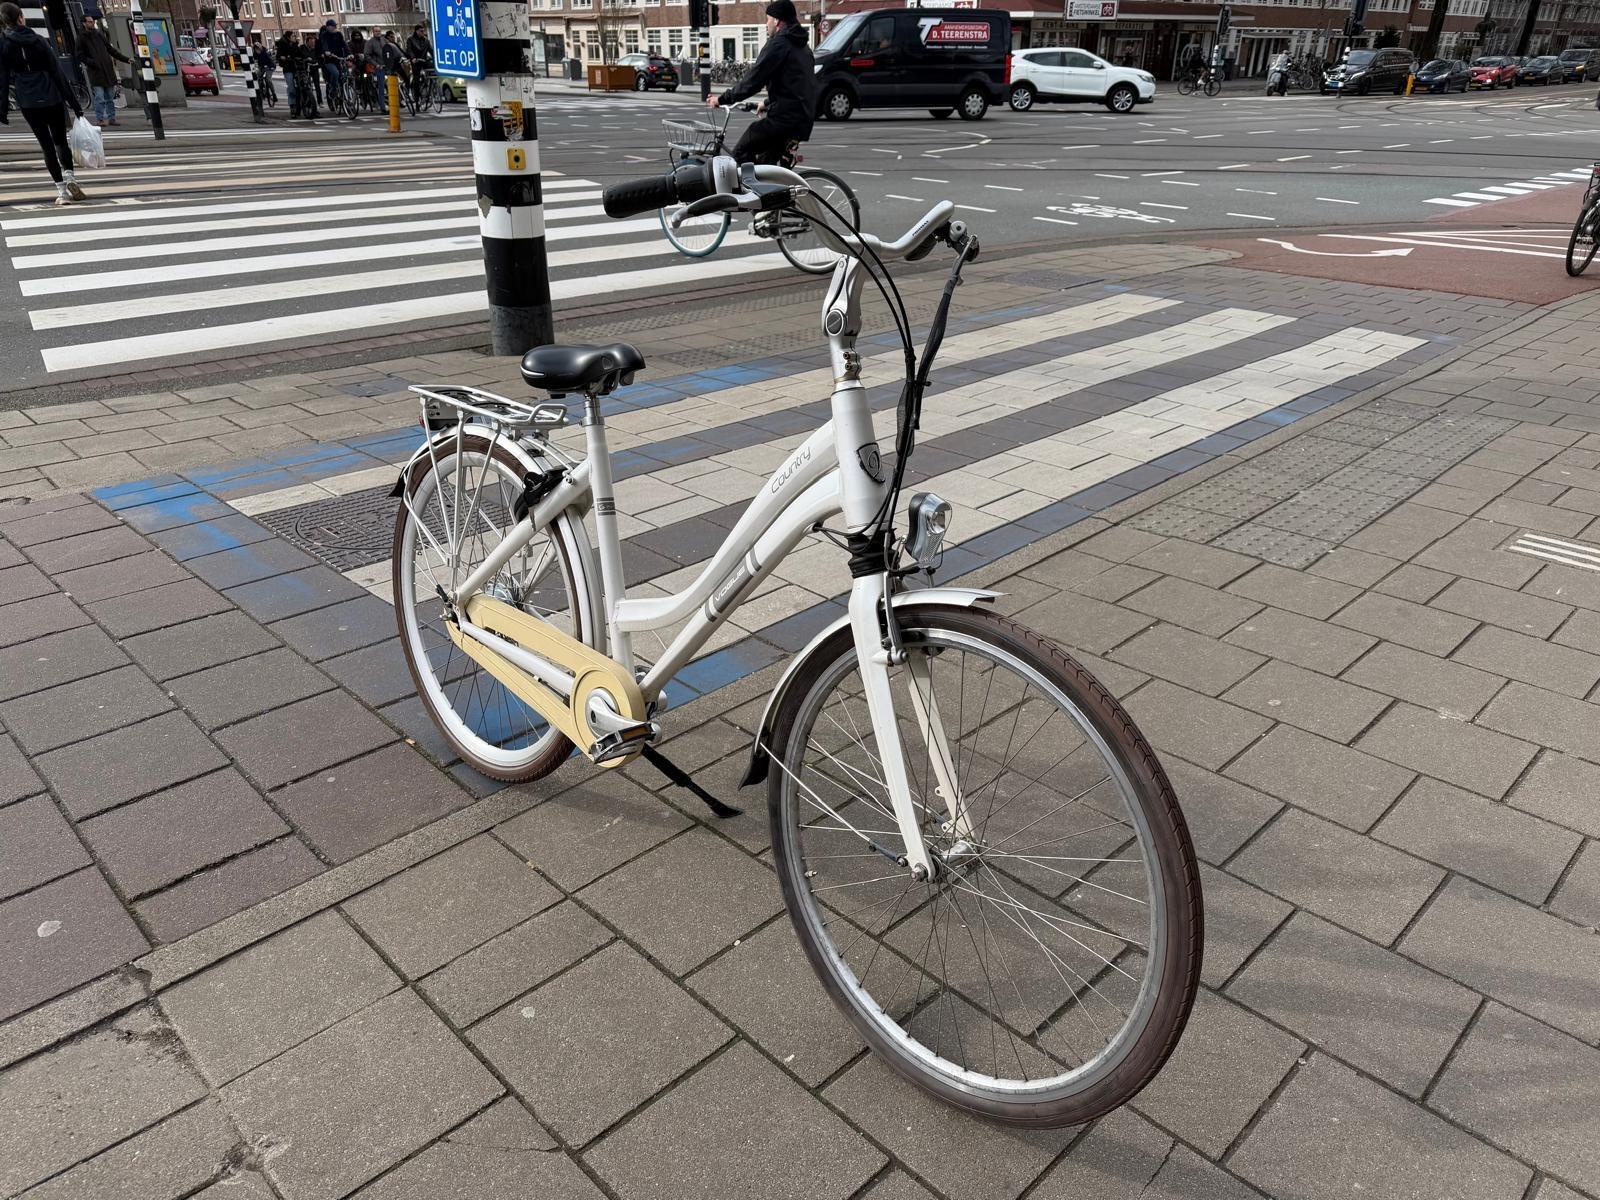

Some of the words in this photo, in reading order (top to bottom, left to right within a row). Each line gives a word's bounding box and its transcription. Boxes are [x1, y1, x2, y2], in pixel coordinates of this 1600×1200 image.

[932, 30, 940, 39] D.
[941, 30, 988, 39] TEERENSTRA
[437, 48, 457, 65] LET
[460, 50, 475, 67] OP
[771, 446, 811, 494] Country
[714, 565, 745, 601] VOGUE
